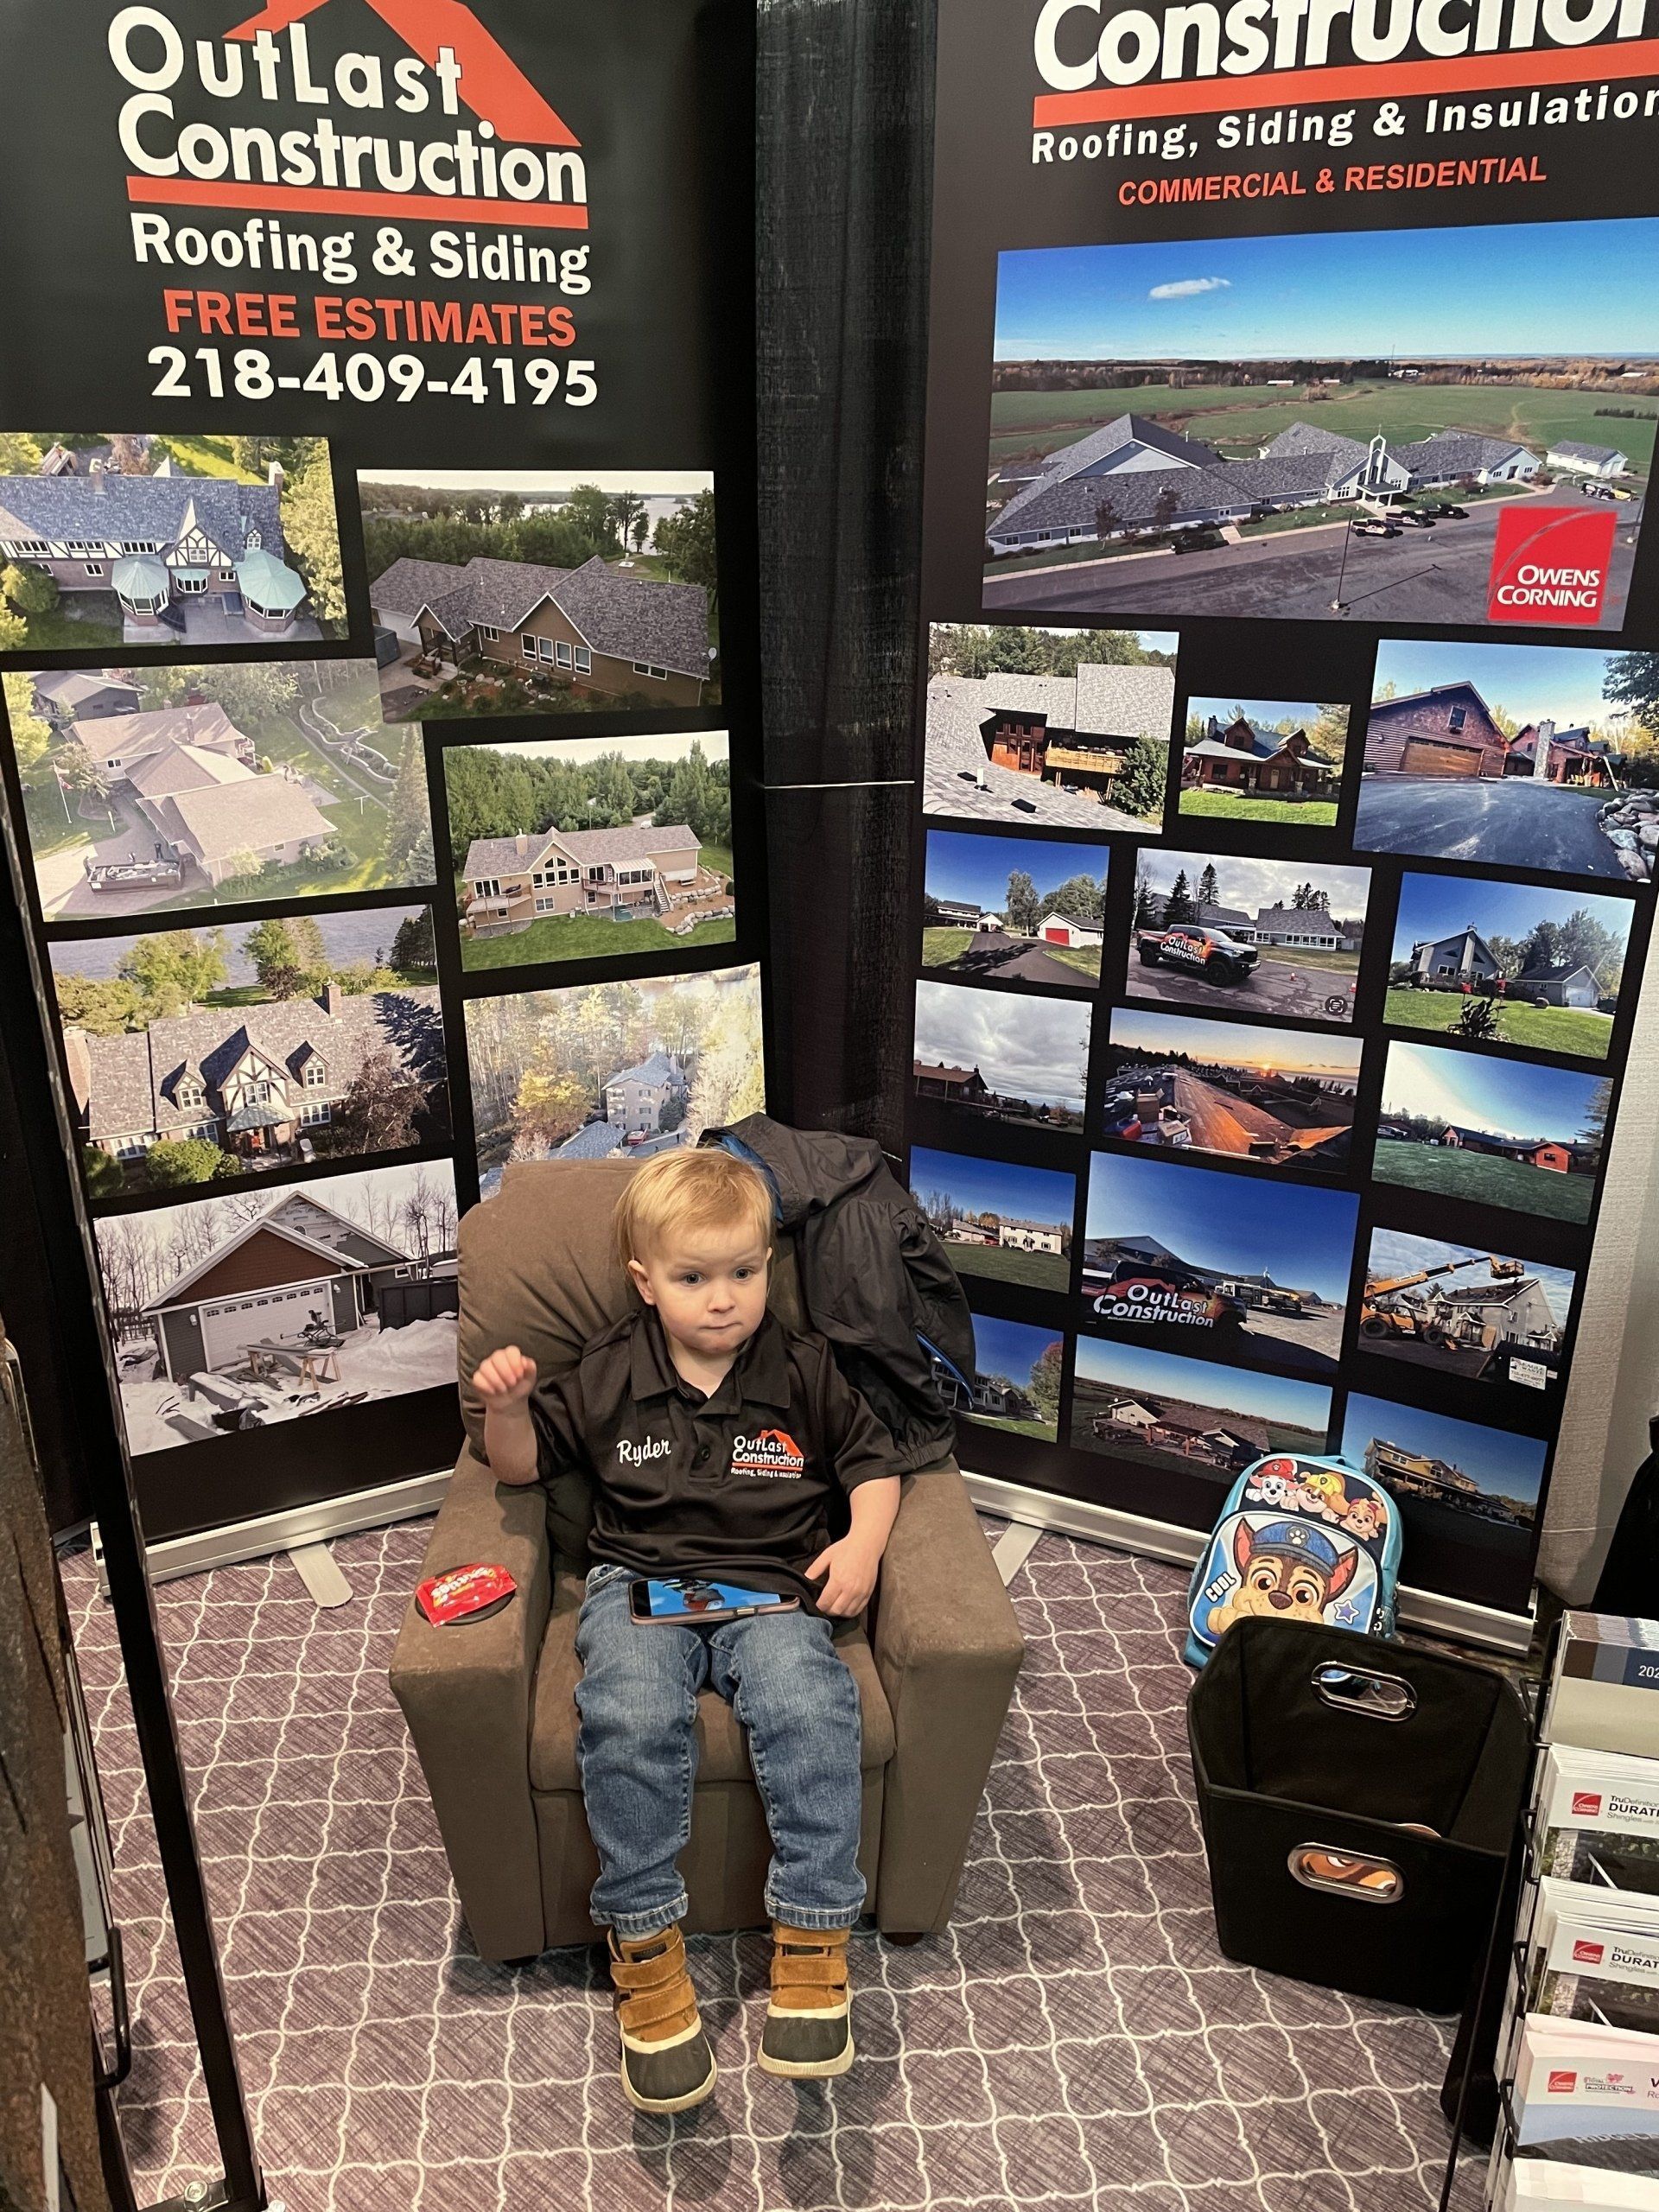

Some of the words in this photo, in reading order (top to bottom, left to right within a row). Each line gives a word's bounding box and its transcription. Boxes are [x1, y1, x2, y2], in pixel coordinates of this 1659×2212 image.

[107, 5, 463, 115] OutLast
[118, 92, 588, 203] Construction
[1032, 124, 1198, 163] Roofing,
[1217, 110, 1356, 147] Siding
[1372, 102, 1406, 137] &
[1119, 171, 1306, 206] COMMERCIAL
[1315, 168, 1335, 193] &
[1344, 156, 1547, 192] RESIDENTIAL
[130, 212, 358, 283] Roofing
[372, 226, 416, 276] &
[430, 231, 592, 296] Siding
[163, 289, 301, 338] FREE
[314, 296, 576, 346] ESTIMATES
[148, 346, 597, 406] 218-409-4195
[1517, 564, 1601, 587] OWENS
[1497, 585, 1598, 608] CORNING
[1160, 942, 1206, 965] Construction
[1093, 1294, 1214, 1328] Construction
[1127, 1284, 1208, 1315] OutLast
[616, 1435, 672, 1468] Ryder
[732, 1448, 804, 1467] Construction
[734, 1435, 787, 1453] OutLast
[1205, 1572, 1236, 1603] COOL
